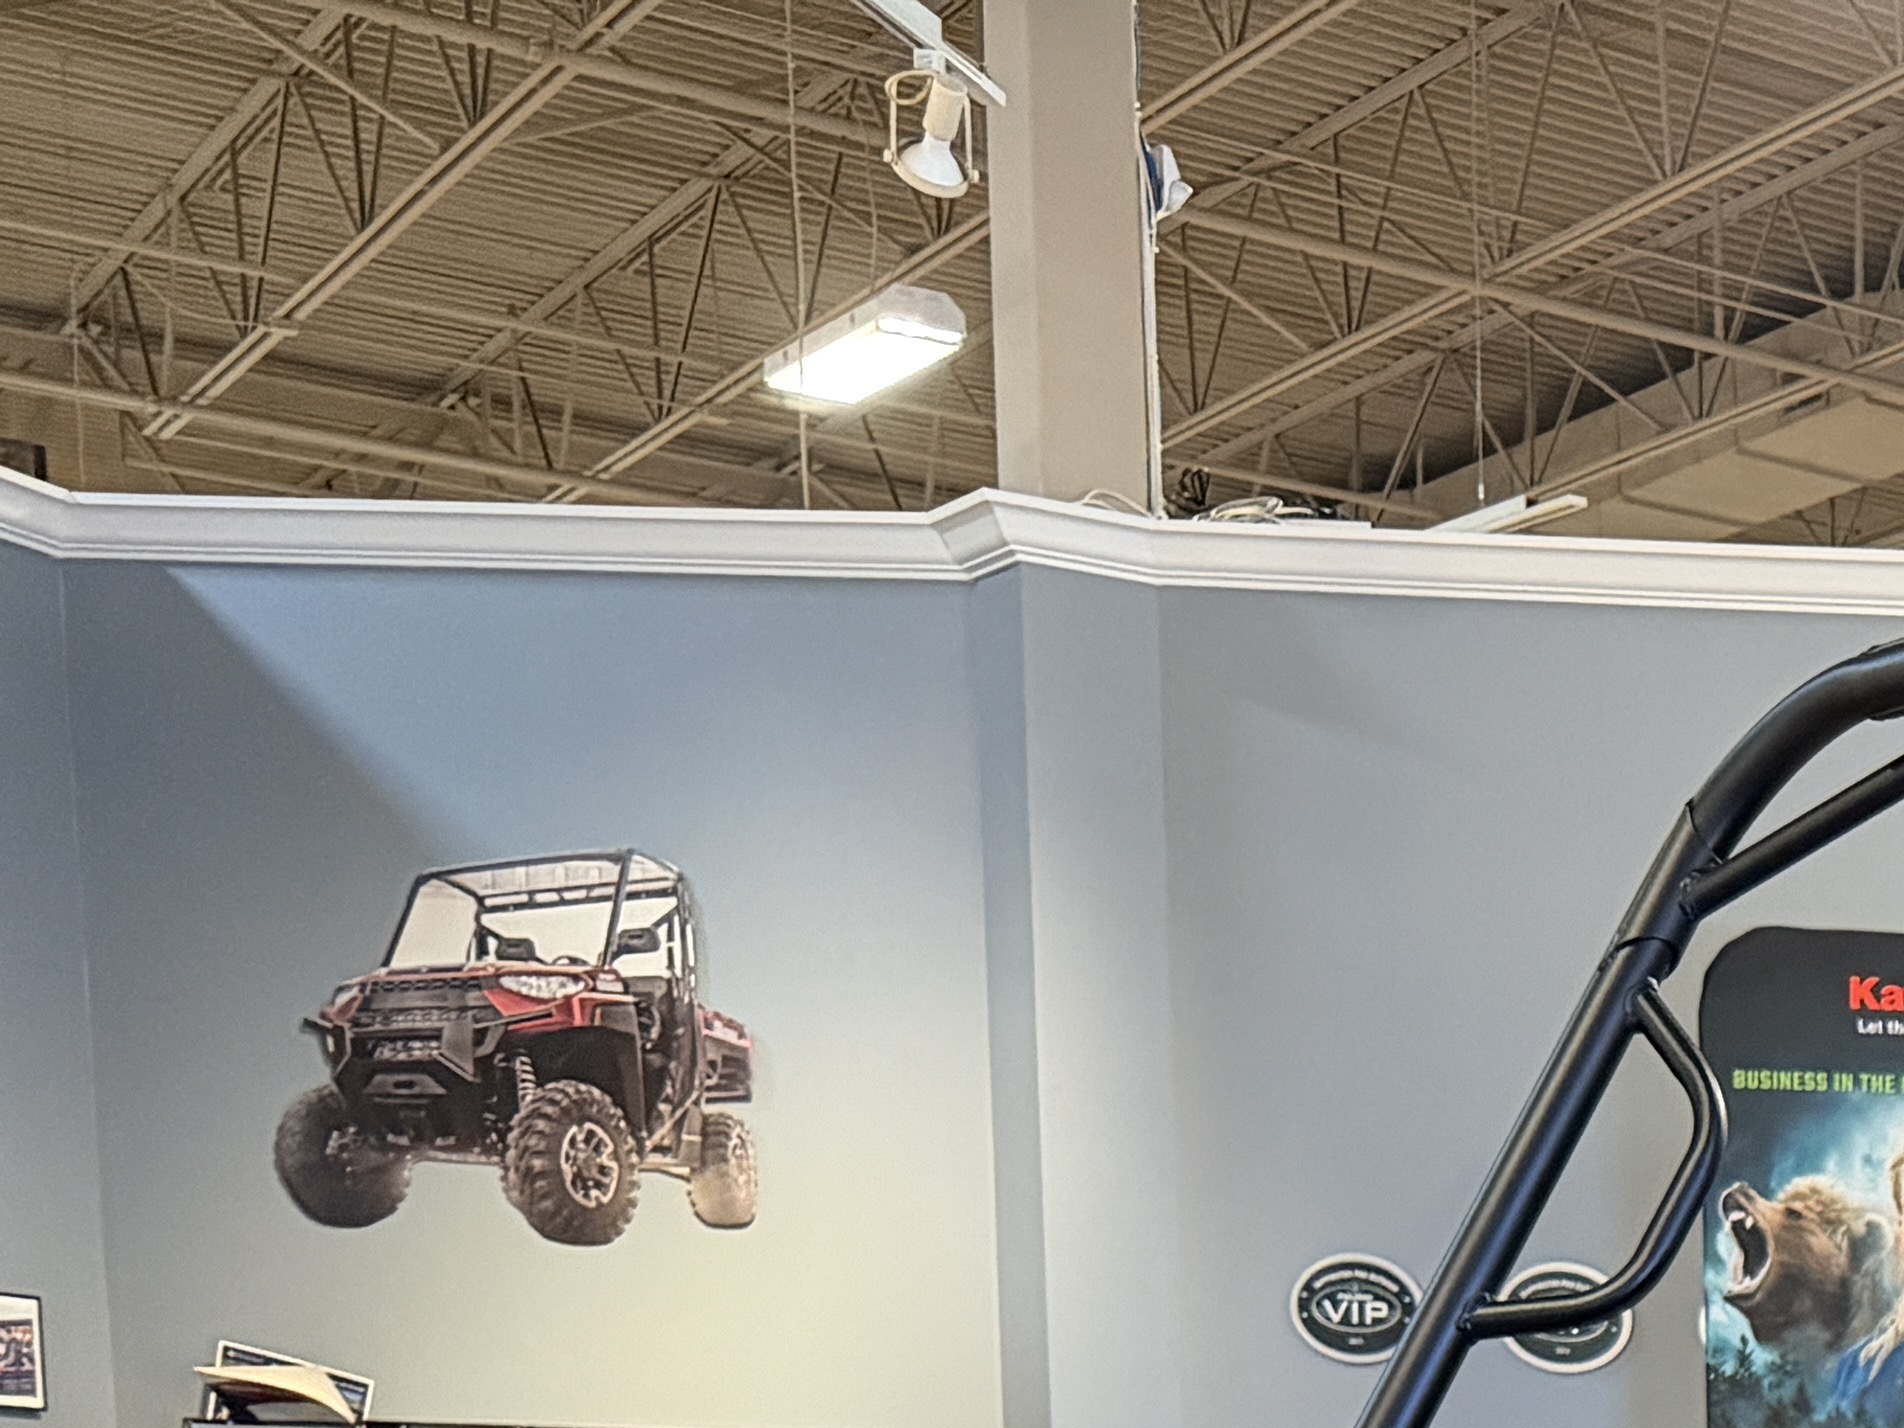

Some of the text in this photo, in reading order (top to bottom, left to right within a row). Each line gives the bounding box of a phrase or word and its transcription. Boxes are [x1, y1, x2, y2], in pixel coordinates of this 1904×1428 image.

[1857, 1018, 1882, 1036] Let
[1733, 1069, 1828, 1092] BUSINESS
[1834, 1073, 1853, 1092] IN
[1860, 1073, 1896, 1094] THE
[1322, 1299, 1389, 1325] VIP
